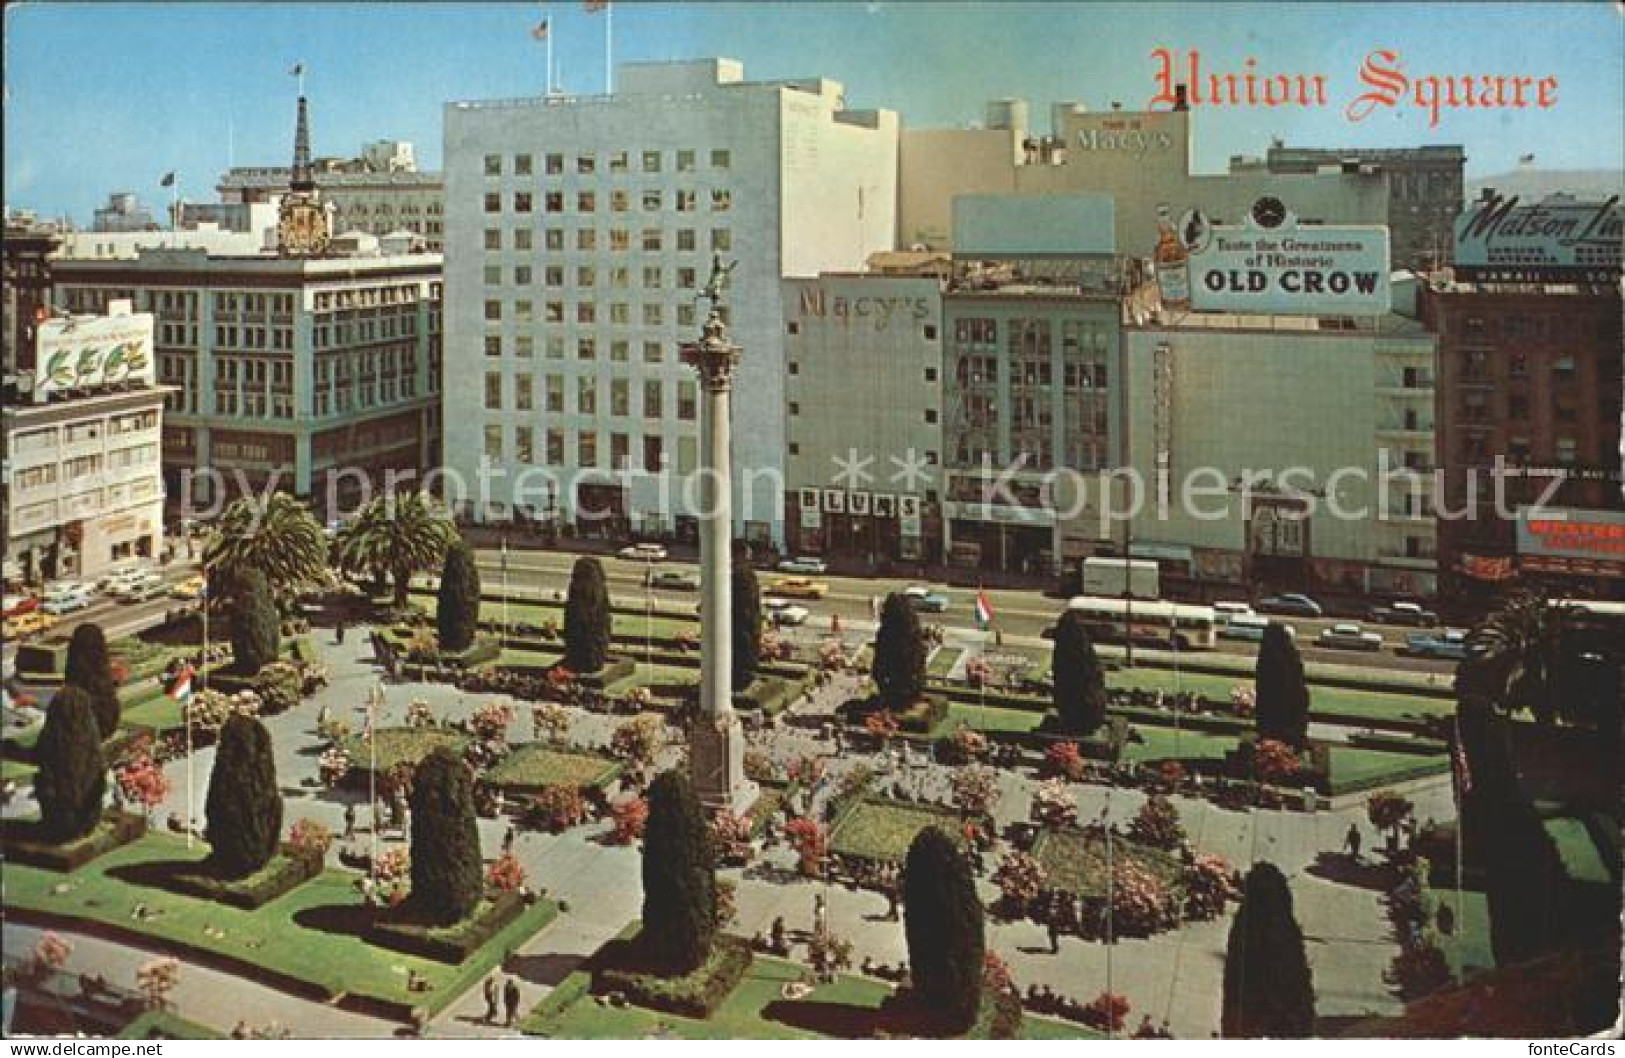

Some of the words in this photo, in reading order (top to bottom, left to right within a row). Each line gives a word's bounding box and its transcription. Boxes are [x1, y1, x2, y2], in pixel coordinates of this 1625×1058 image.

[1204, 268, 1269, 293] OLD
[1278, 270, 1380, 296] CROW
[800, 287, 929, 332] Macy's
